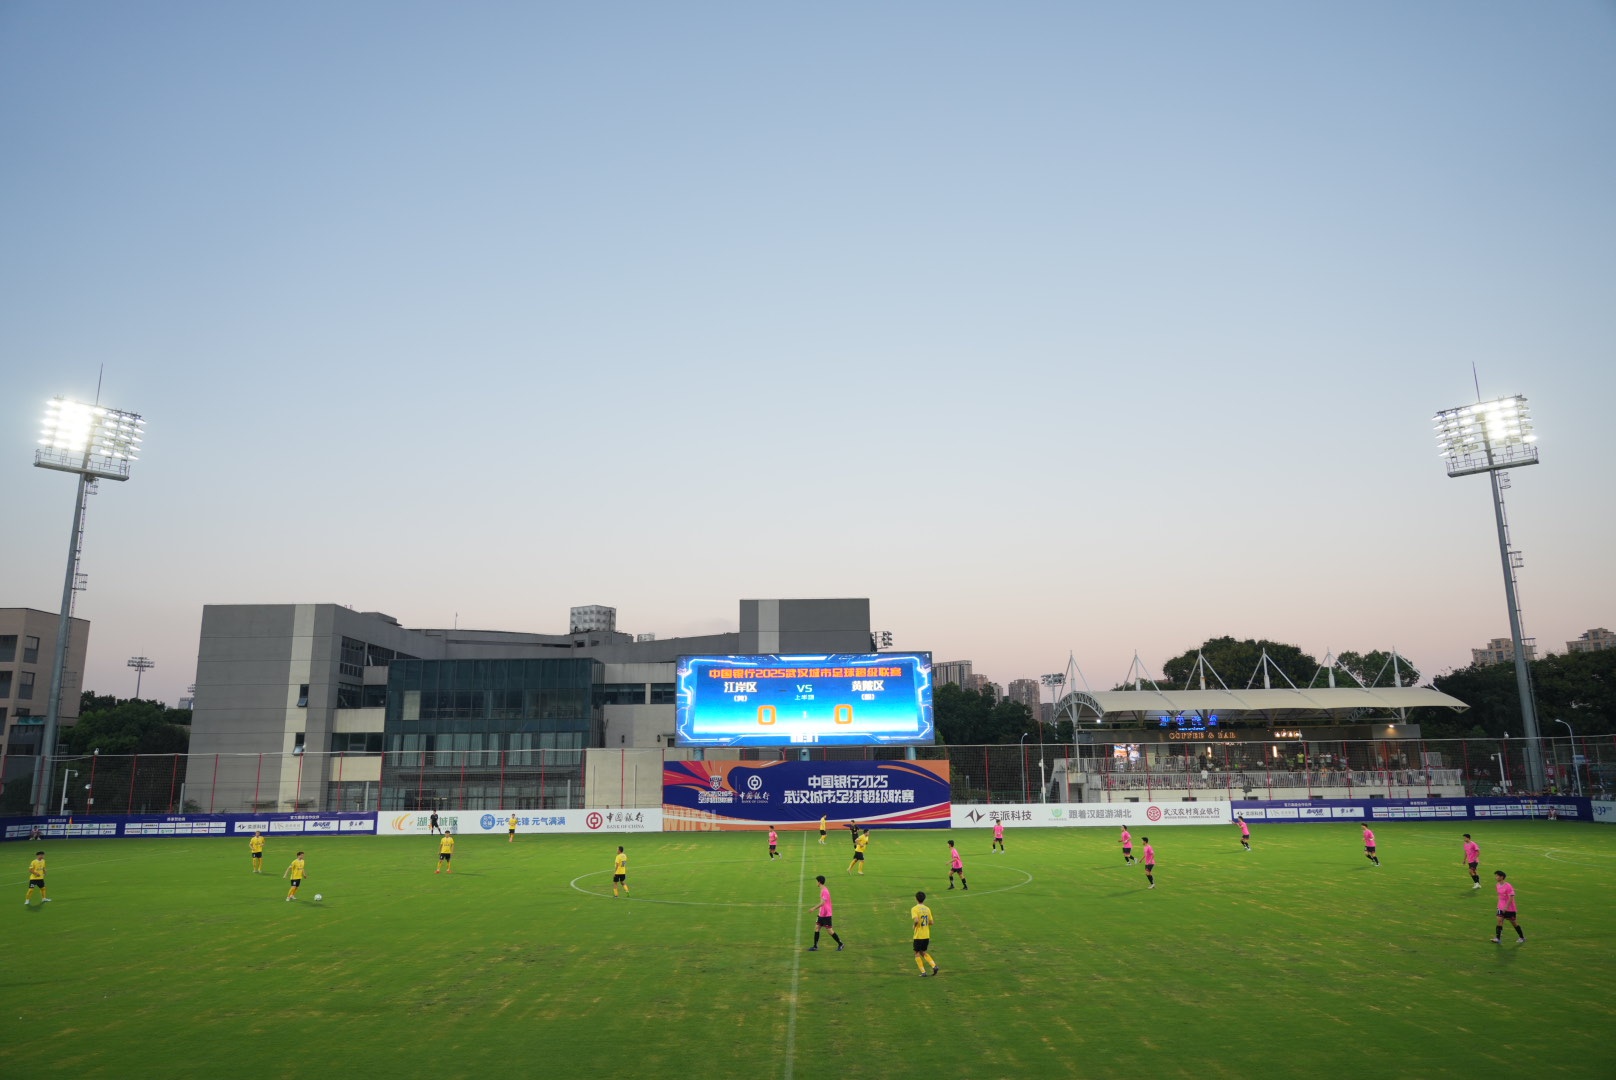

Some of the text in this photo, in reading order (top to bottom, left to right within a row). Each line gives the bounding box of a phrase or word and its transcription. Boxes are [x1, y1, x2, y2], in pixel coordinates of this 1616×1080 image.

[708, 667, 902, 679] 中国银行2025武汉城市足球超级联赛
[724, 681, 757, 693] 江岸区
[796, 684, 813, 693] VS
[851, 680, 885, 692] 黄陂区
[757, 705, 776, 726] 0
[833, 704, 853, 725] 0
[808, 774, 889, 788] 中国银行2025
[783, 789, 915, 804] 武汉城市足球超级联赛
[606, 811, 645, 823] 中国银行
[989, 810, 1032, 821] 奕派科技
[1068, 809, 1132, 819] 跟着汉超游湖北
[1163, 807, 1221, 816] 武汉农村商业银行
[531, 816, 566, 826] 元气满满
